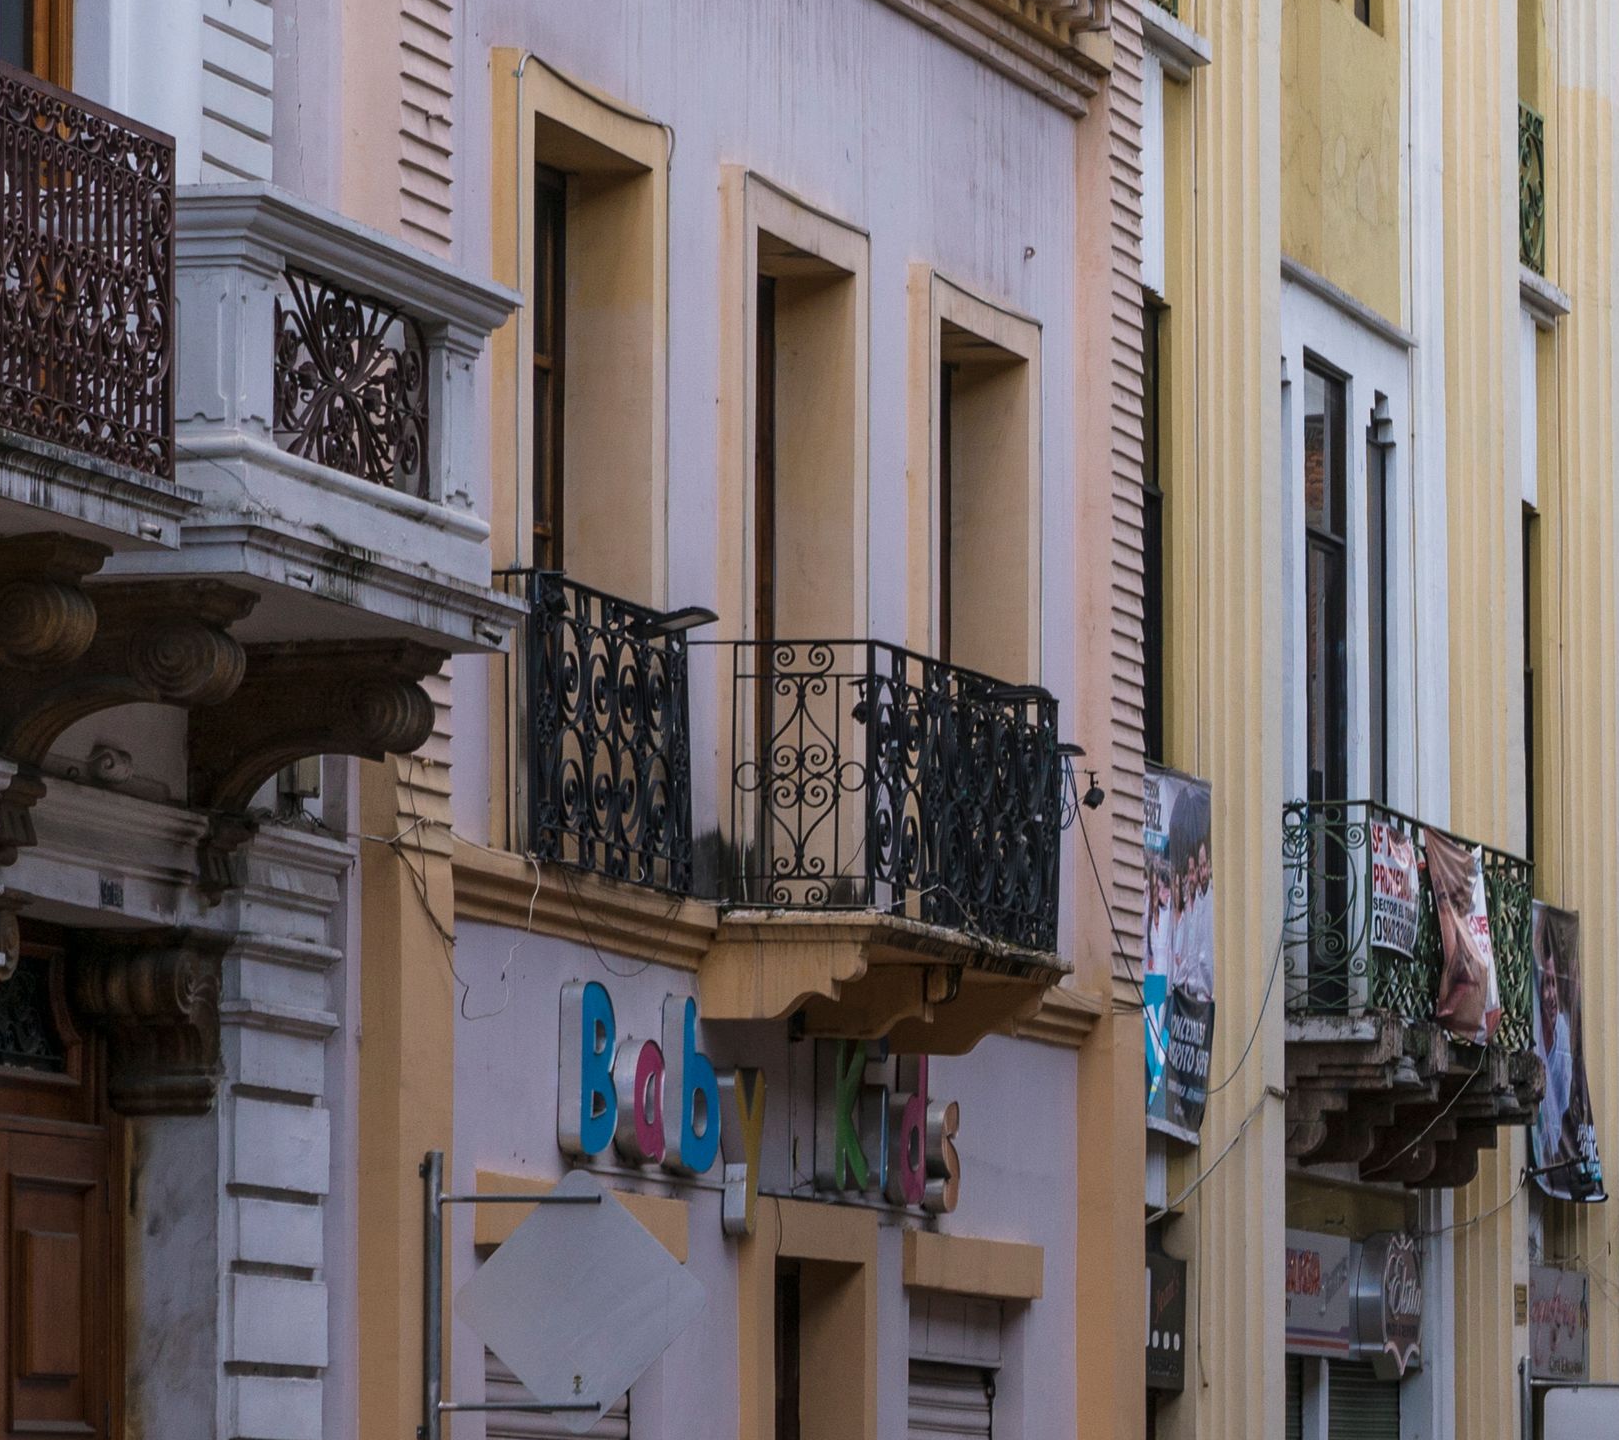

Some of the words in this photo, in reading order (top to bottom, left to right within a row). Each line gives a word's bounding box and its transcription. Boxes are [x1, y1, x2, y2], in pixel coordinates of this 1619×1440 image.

[1373, 898, 1398, 916] SECTOR
[565, 981, 766, 1236] Baby
[823, 1038, 960, 1213] Kids
